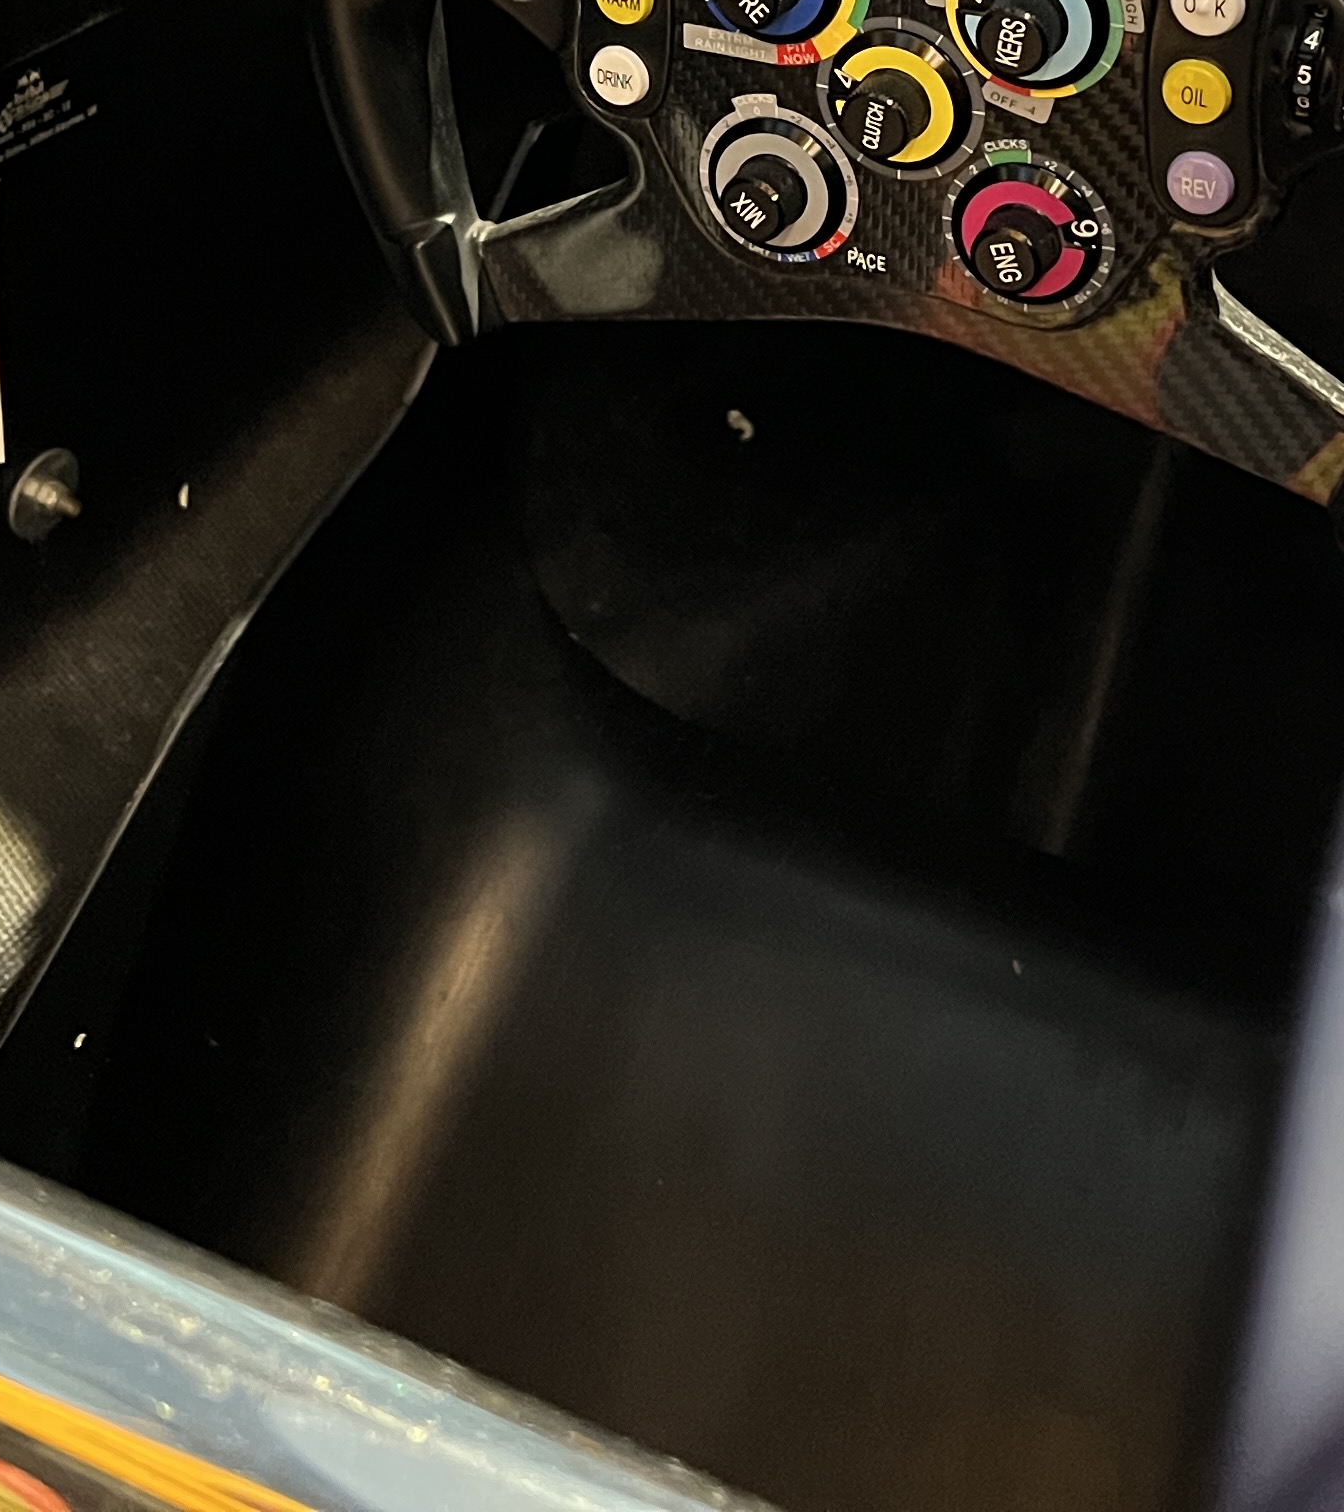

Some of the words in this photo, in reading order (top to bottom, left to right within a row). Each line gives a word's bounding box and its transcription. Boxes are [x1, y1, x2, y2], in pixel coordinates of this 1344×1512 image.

[695, 38, 725, 53] RAIN
[728, 43, 766, 59] LIGHT
[786, 43, 806, 54] PIT
[995, 18, 1026, 67] KERS
[1303, 30, 1320, 50] 4
[783, 53, 815, 65] NOW
[597, 68, 633, 91] DRINK
[1297, 64, 1312, 85] 5
[990, 90, 1017, 109] OFF
[1181, 85, 1208, 109] OIL
[862, 101, 885, 150] CLUTCH
[984, 139, 1028, 152] CLICKS
[1181, 177, 1217, 199] REV
[729, 191, 766, 230] MIX
[822, 238, 841, 253] SC
[787, 252, 811, 263] WET
[847, 247, 886, 272] PACE
[989, 242, 1023, 283] ENG
